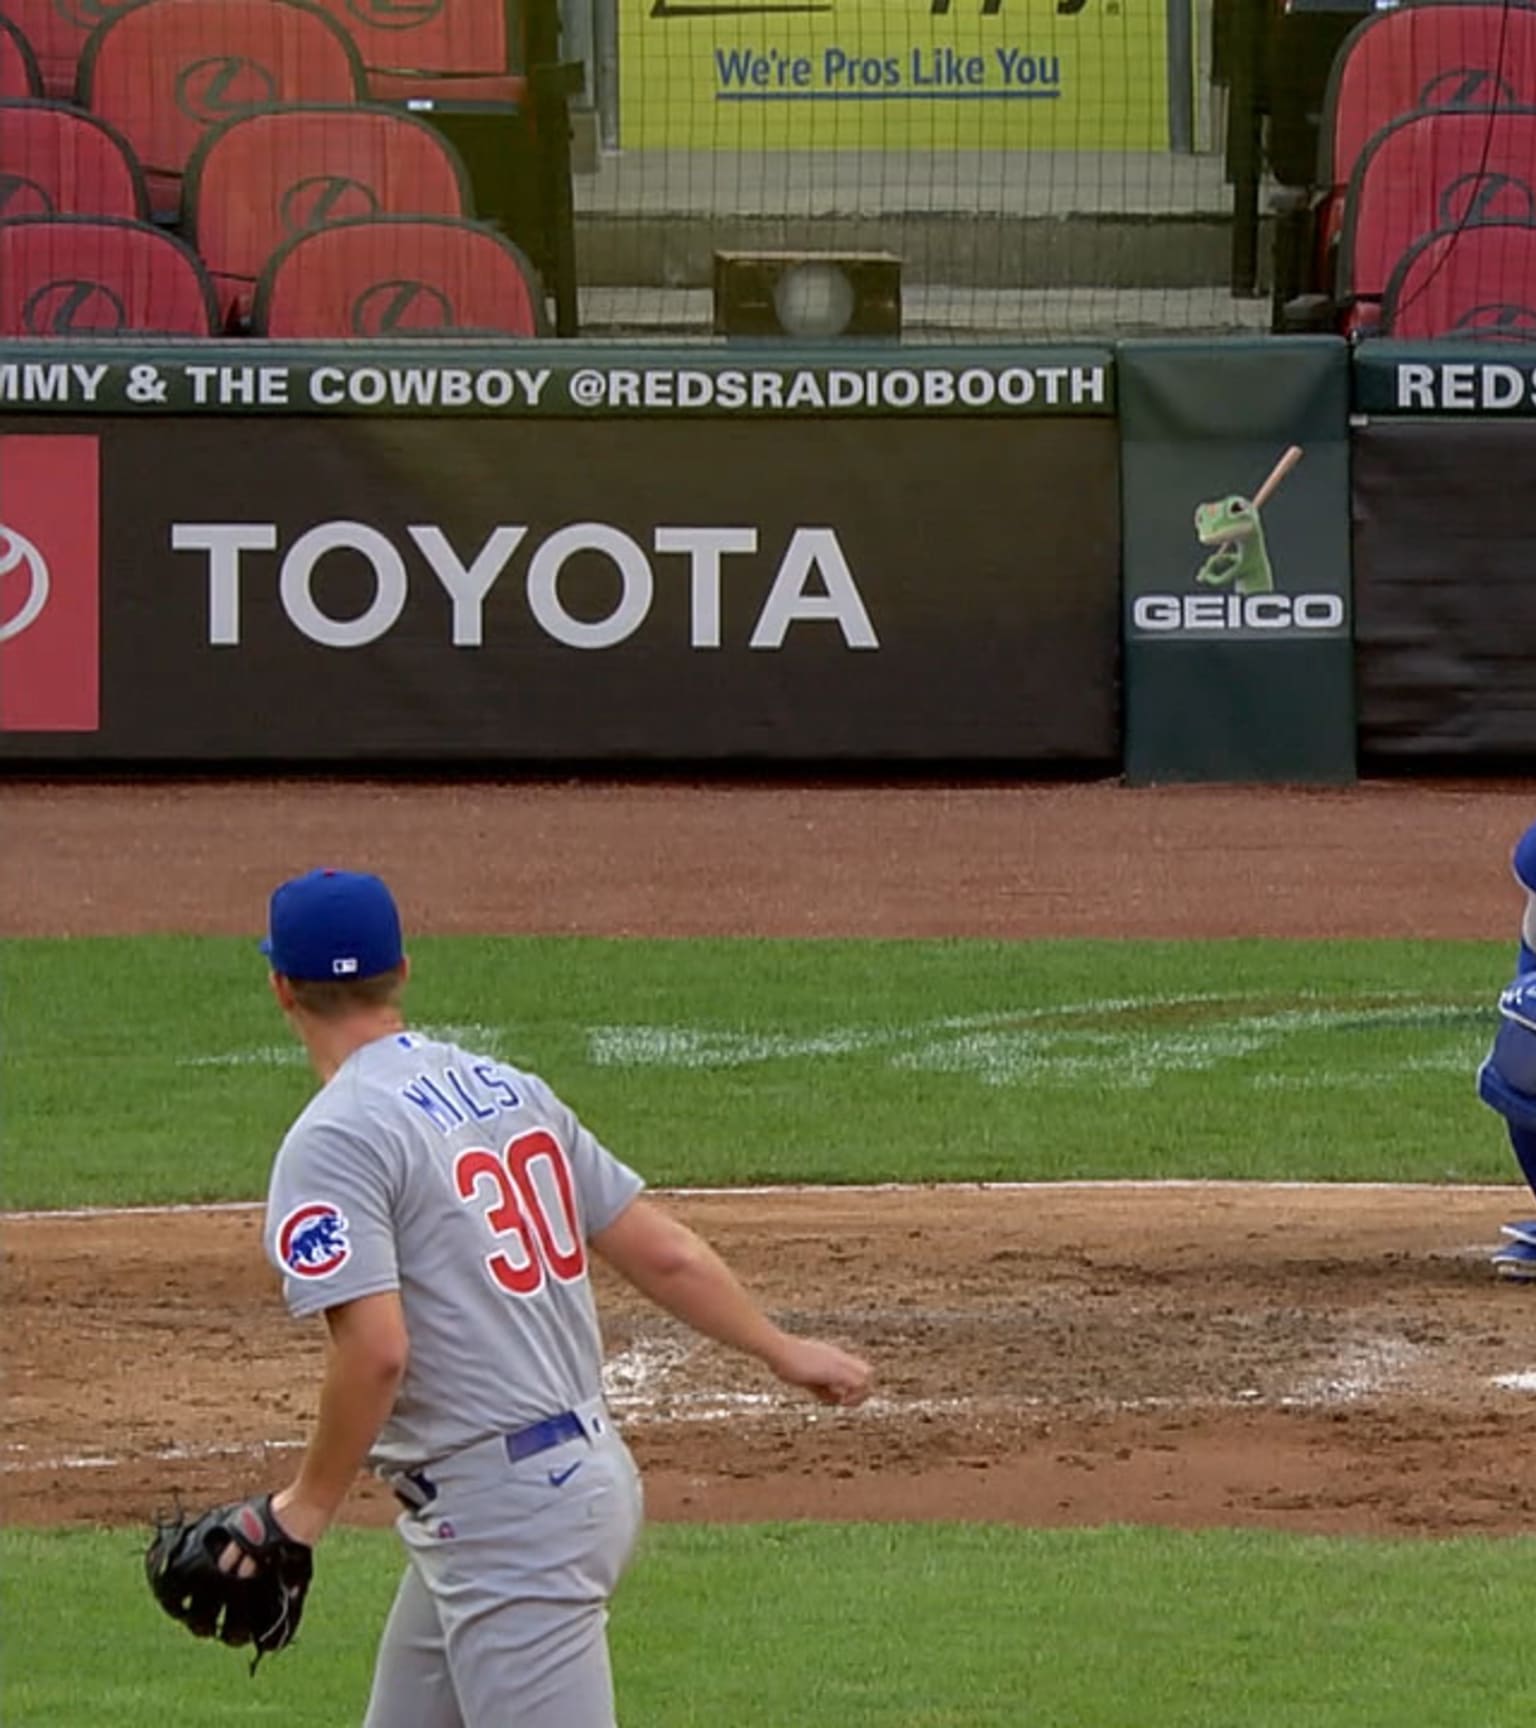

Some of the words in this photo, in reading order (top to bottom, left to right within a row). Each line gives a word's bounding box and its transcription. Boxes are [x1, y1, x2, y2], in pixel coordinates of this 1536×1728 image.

[715, 47, 811, 87] We're
[824, 48, 900, 87] Pros
[912, 47, 985, 86] Like
[996, 47, 1060, 86] You
[126, 363, 168, 403] &
[186, 366, 290, 404] THE
[309, 366, 552, 406] COWBOY
[569, 367, 1106, 410] @REDSRADIOBOOTH
[171, 520, 881, 651] TOYOTA
[1132, 592, 1345, 631] GEICO
[453, 1126, 588, 1296] 30
